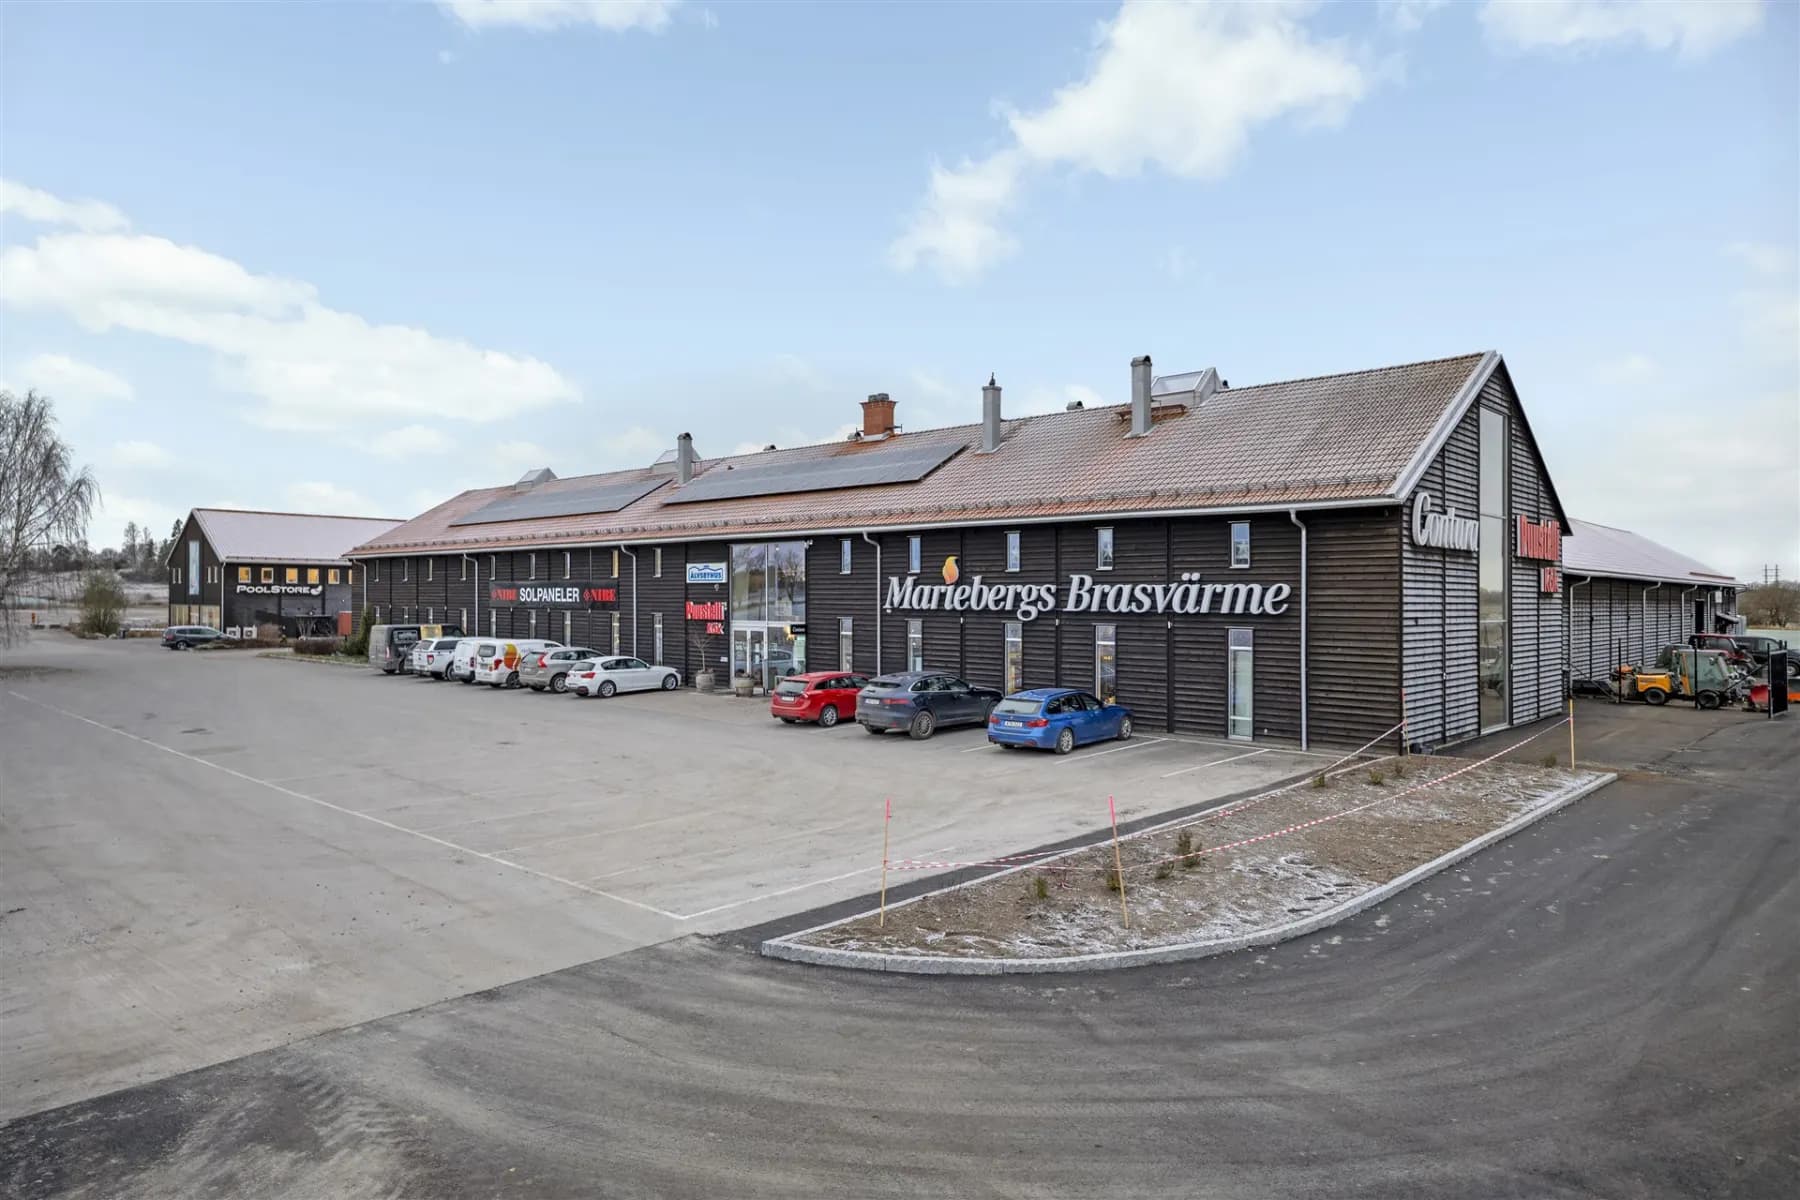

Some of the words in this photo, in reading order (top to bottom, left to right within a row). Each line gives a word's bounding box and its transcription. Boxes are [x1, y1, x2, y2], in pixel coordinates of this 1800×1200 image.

[1412, 492, 1478, 551] Contura
[520, 587, 580, 602] SOLPANELER
[883, 574, 1057, 622] Mariebergs
[1063, 572, 1291, 615] Brasvärme
